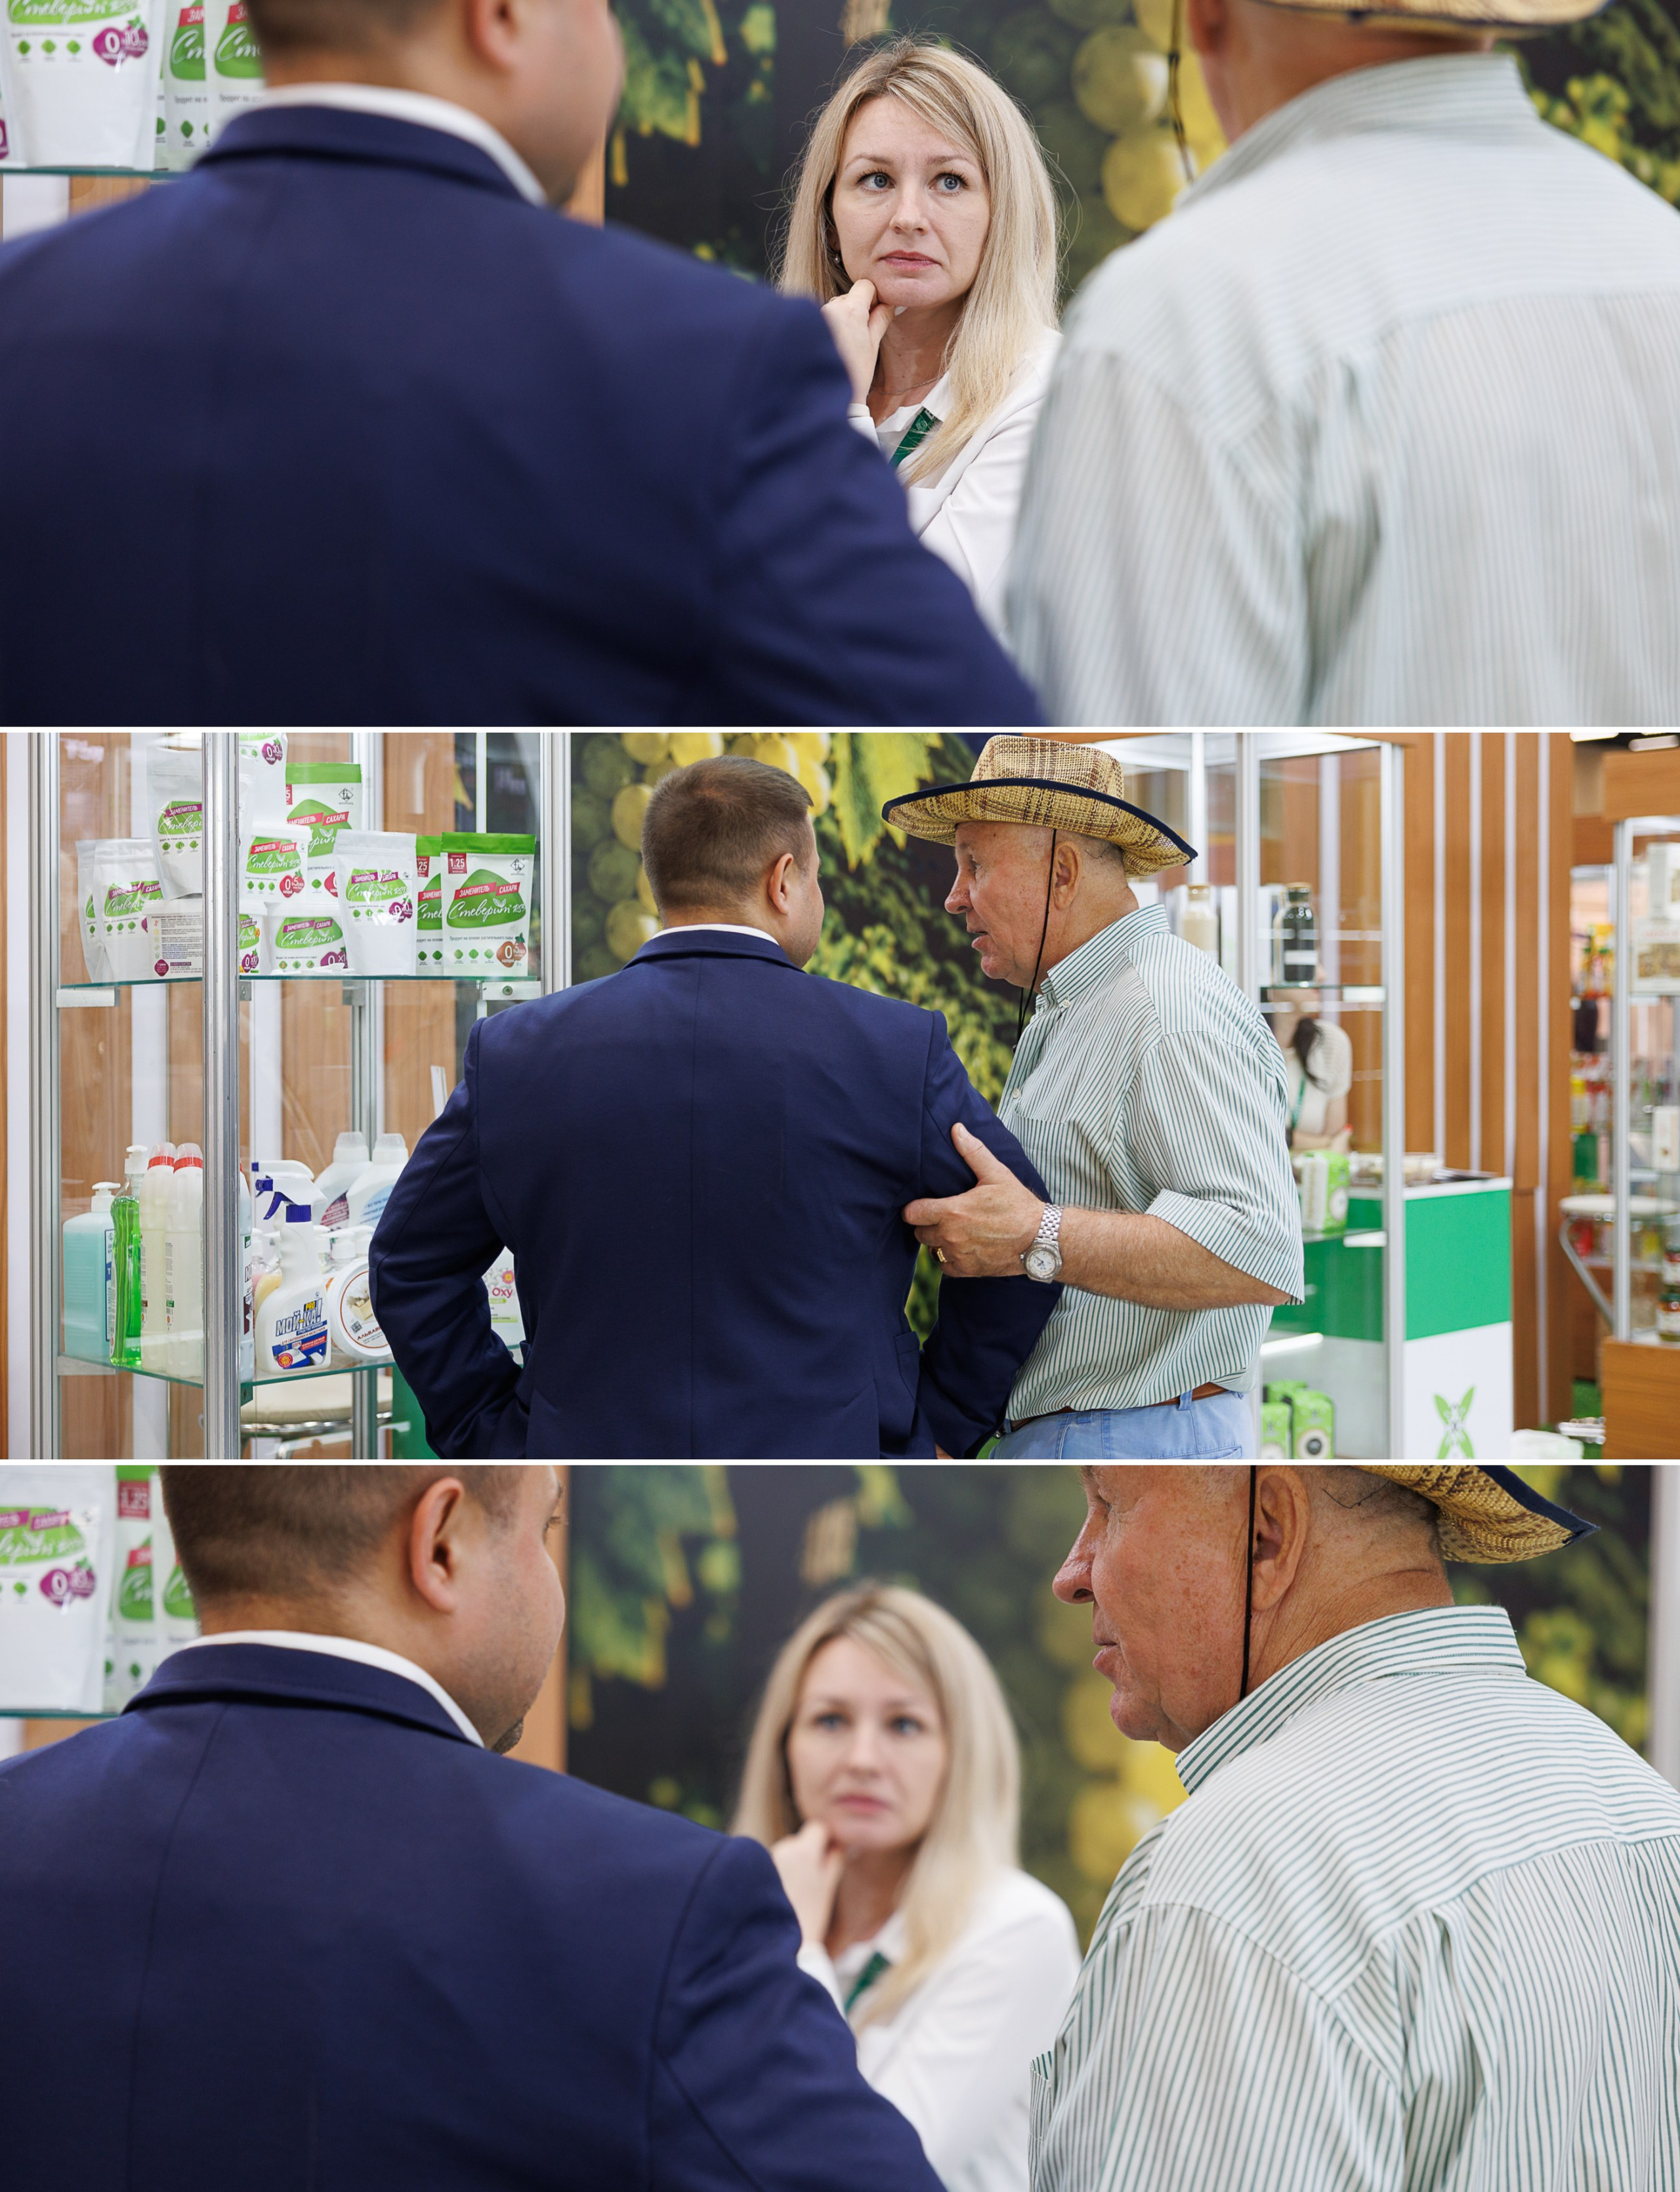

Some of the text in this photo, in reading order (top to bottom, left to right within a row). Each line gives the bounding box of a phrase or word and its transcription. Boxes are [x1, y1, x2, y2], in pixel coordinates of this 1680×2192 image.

[105, 32, 120, 53] 0
[266, 746, 273, 757] 0
[326, 814, 346, 824] САХАРА
[247, 854, 287, 874] Стеверит
[450, 858, 465, 868] 1.25
[285, 879, 291, 891] 0
[459, 884, 518, 897] ЗАМЕНИТЕЛЬ САХАРА
[348, 883, 392, 901] Стверит
[448, 898, 510, 923] Стеверит
[286, 923, 310, 932] ЗАМЕНИТЕЛЬ
[281, 930, 333, 947] Стеверит
[505, 945, 513, 959] 0
[245, 956, 249, 967] 0
[492, 1287, 513, 1299] Oxy
[305, 1301, 316, 1311] PRO
[51, 1570, 68, 1596] 0
